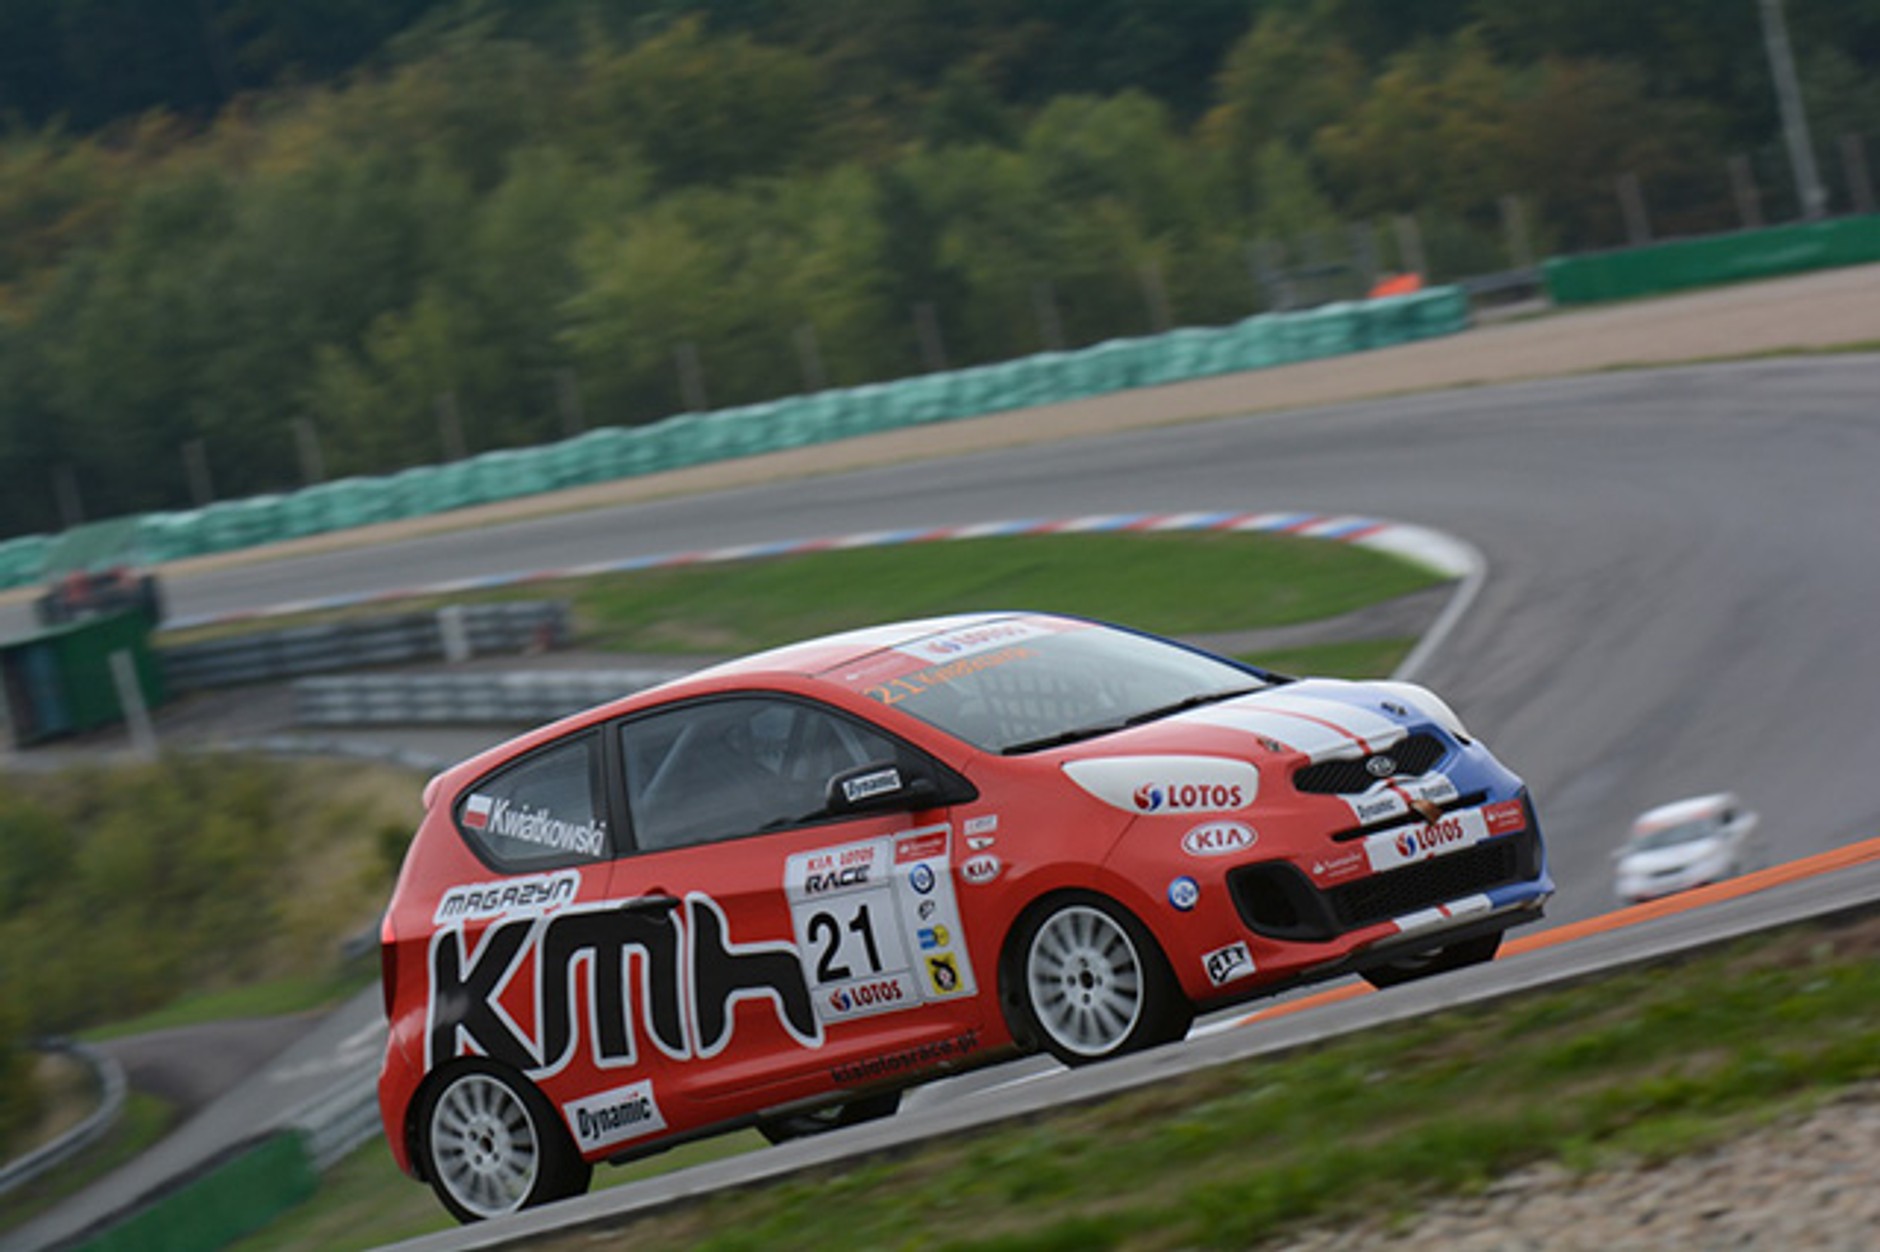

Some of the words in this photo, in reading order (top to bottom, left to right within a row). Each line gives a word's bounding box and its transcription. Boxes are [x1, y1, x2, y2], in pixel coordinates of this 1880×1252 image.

[1168, 785, 1242, 807] LOTOS
[489, 798, 607, 856] Kwiatkowski
[1196, 828, 1244, 849] KIA
[1416, 817, 1464, 850] LOTOS
[807, 856, 833, 871] KIA
[840, 847, 875, 866] LOTOS
[966, 859, 994, 877] KIA
[805, 864, 871, 893] RACE
[440, 877, 575, 917] MAGAZYN
[807, 904, 882, 983] 21
[851, 978, 903, 1006] LOTOS
[577, 1096, 651, 1139] Dynamic
